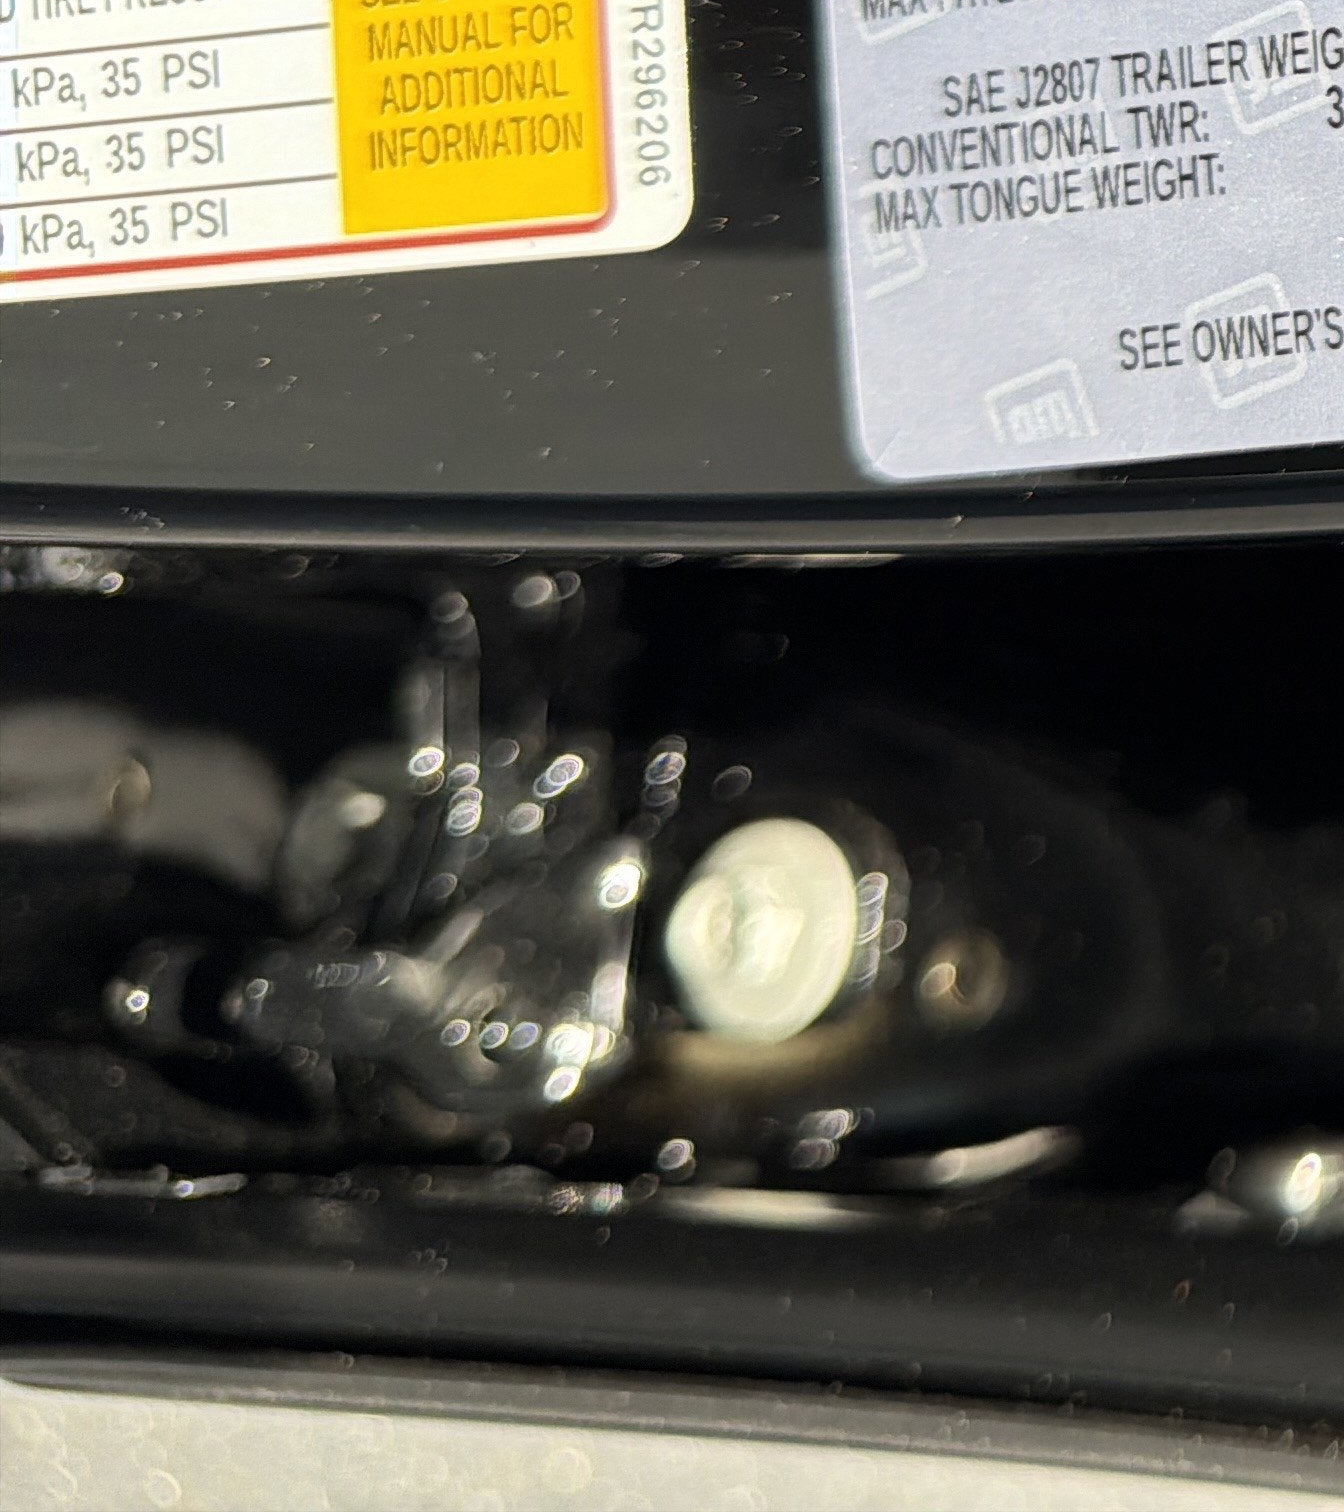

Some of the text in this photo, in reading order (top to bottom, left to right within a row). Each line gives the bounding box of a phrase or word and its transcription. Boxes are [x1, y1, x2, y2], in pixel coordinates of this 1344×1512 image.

[367, 2, 573, 61] MANUAL FOR
[12, 50, 219, 111] kPa, 35 PSI
[380, 59, 569, 115] ADDITIONAL
[943, 70, 1006, 117] SAE
[1016, 57, 1100, 109] J2807
[1111, 39, 1248, 96] TRAILER
[16, 125, 223, 185] kPa, 35 PSI
[368, 112, 582, 170] INFORMATION
[871, 111, 1120, 179] CONVENTIONAL
[1125, 101, 1209, 149] TWR:
[873, 186, 941, 233] MAX
[948, 169, 1083, 223] TONGUE
[1091, 153, 1225, 209] WEIGHT:
[21, 214, 94, 255] kPa,
[109, 205, 149, 245] 35
[171, 198, 227, 241] PSI
[1119, 323, 1182, 370] SEE
[1192, 307, 1344, 362] OWNER'S
